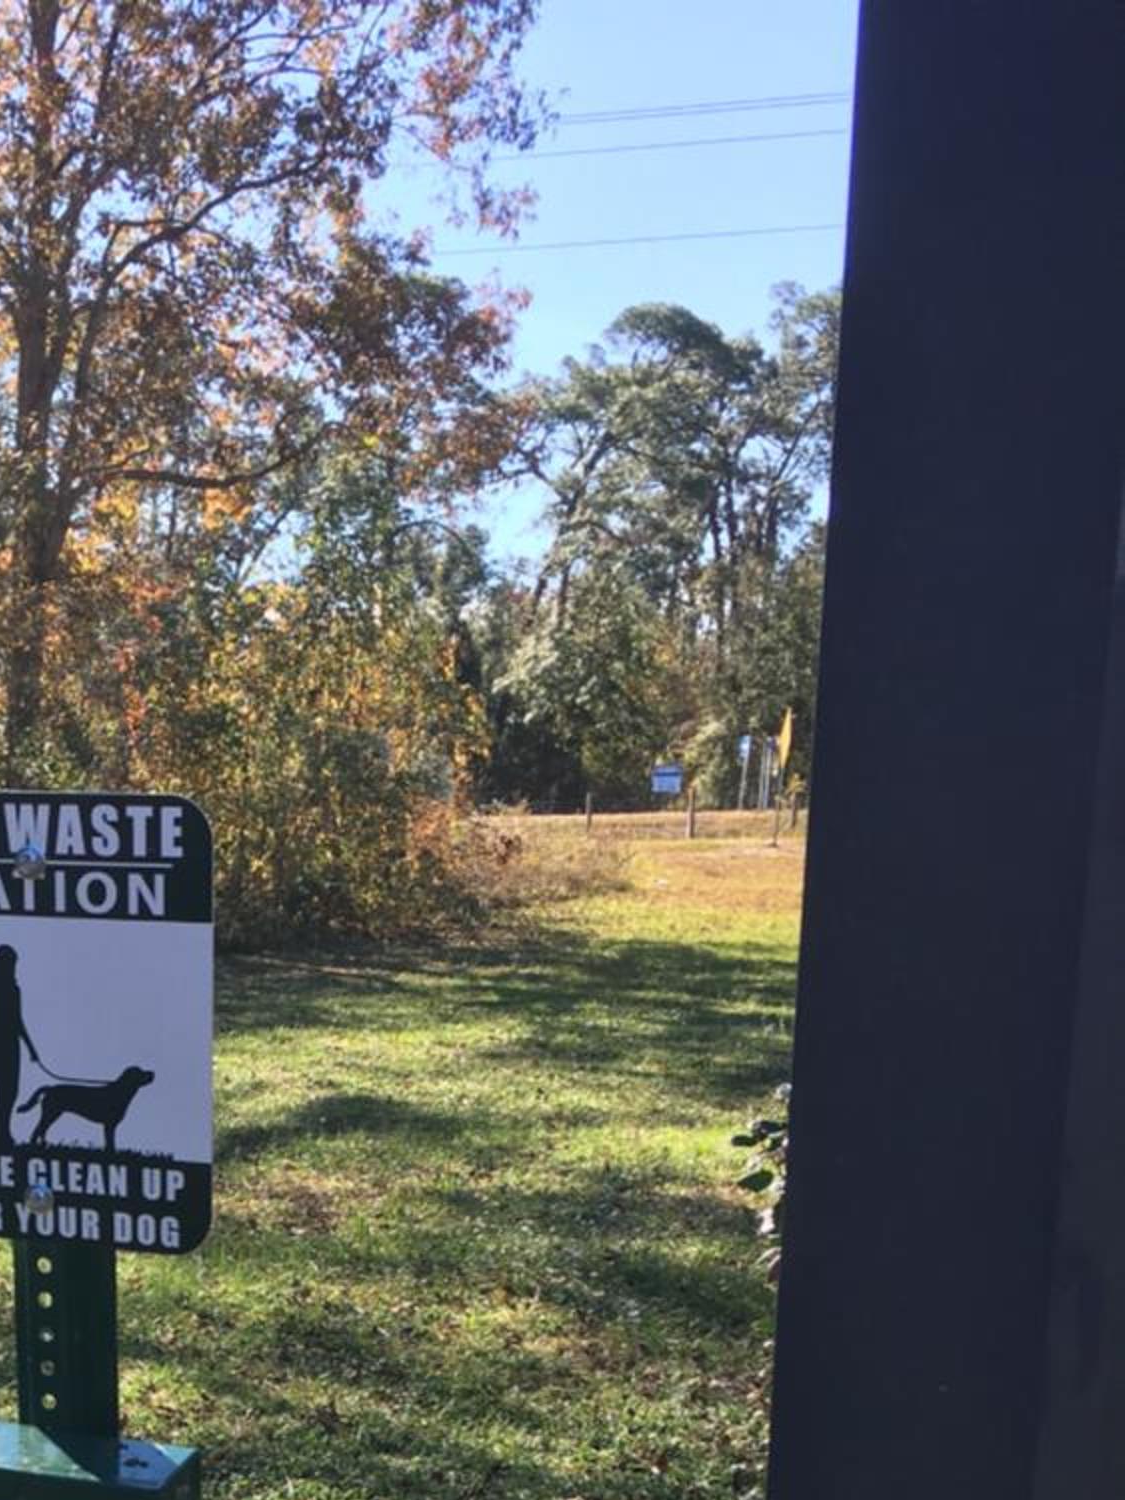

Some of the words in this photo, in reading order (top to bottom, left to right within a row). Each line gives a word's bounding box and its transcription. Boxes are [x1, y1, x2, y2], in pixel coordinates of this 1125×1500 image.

[4, 803, 183, 857] WASTE
[27, 1158, 127, 1197] CLEAN
[142, 1167, 185, 1201] UP
[16, 1202, 99, 1240] YOUR
[113, 1212, 180, 1248] DOG
